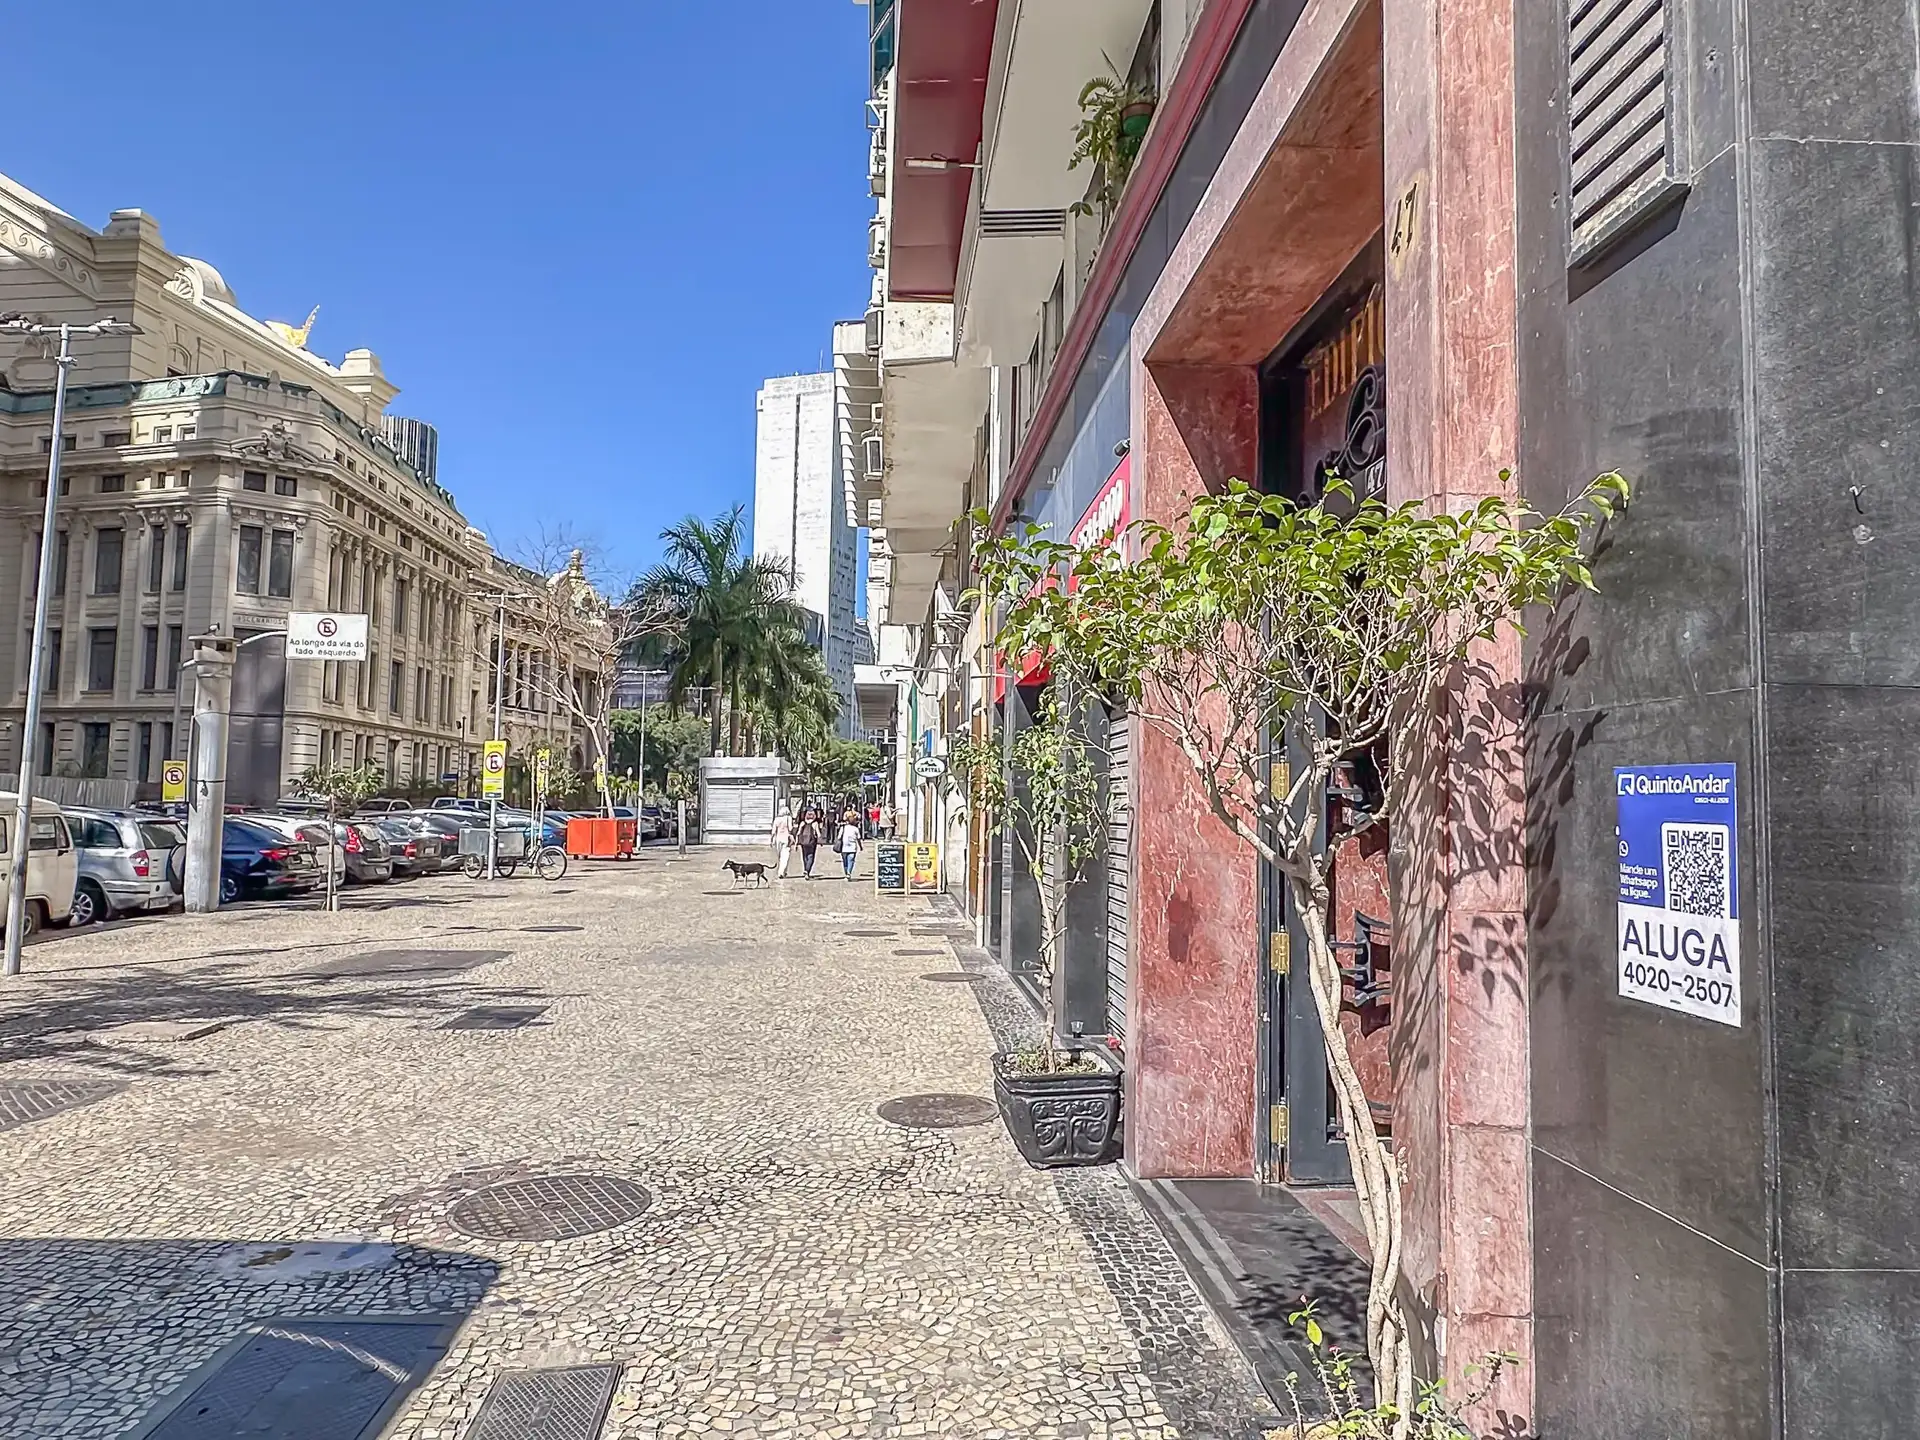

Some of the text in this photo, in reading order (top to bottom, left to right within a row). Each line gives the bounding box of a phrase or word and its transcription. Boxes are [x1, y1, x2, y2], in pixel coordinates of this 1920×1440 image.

[1367, 460, 1384, 494] 47
[289, 638, 364, 648] Ao longo da via do
[295, 647, 357, 657] lado esquerdo
[1636, 773, 1730, 795] QuintoAndar
[1644, 867, 1658, 877] um
[1620, 887, 1629, 896] ou
[1622, 918, 1732, 974] ALUGA
[1623, 961, 1733, 1008] 4020-2507
